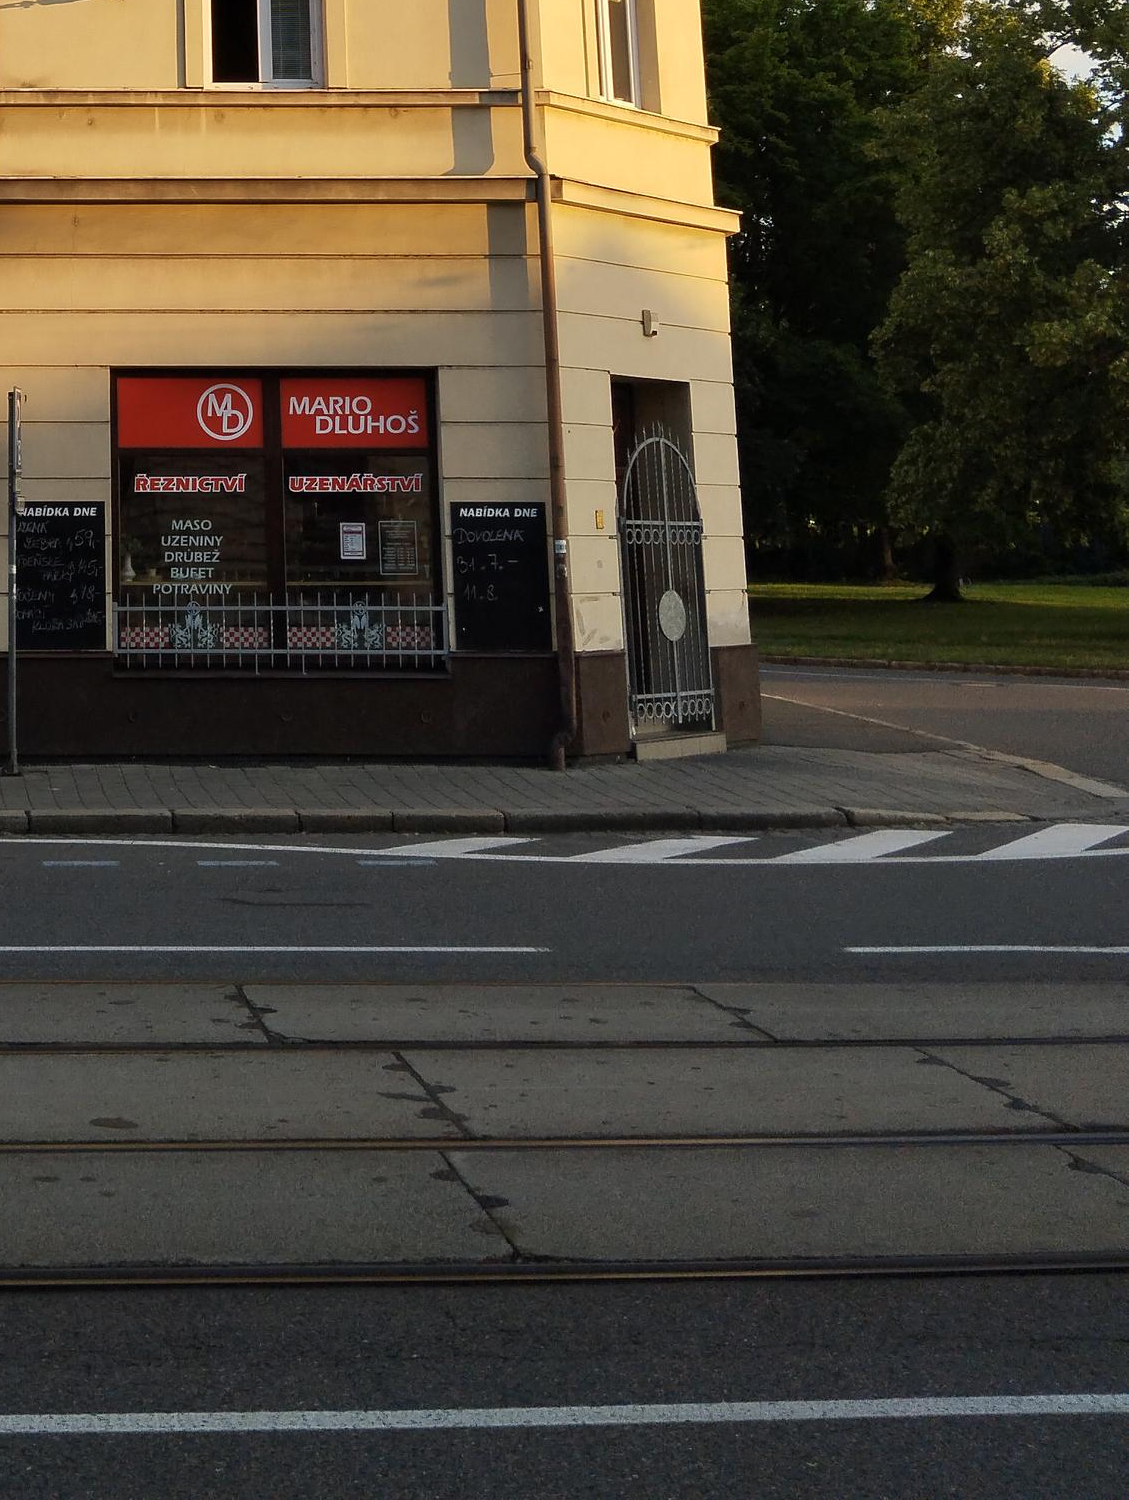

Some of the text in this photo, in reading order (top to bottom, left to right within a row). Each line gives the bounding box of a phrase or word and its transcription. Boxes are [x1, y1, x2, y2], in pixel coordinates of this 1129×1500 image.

[289, 396, 372, 415] MARIO
[315, 410, 420, 434] DLUHOŠ
[134, 473, 247, 492] ŘEZNICTVÍ
[289, 473, 423, 492] UZENÁŘSTVÍ
[73, 507, 97, 517] DNE
[459, 505, 538, 518] NABÍDKA DNE
[171, 519, 212, 530] MASO
[161, 535, 223, 547] UZENINY
[170, 567, 214, 578] BUFET
[153, 583, 232, 594] POTRAVINY
